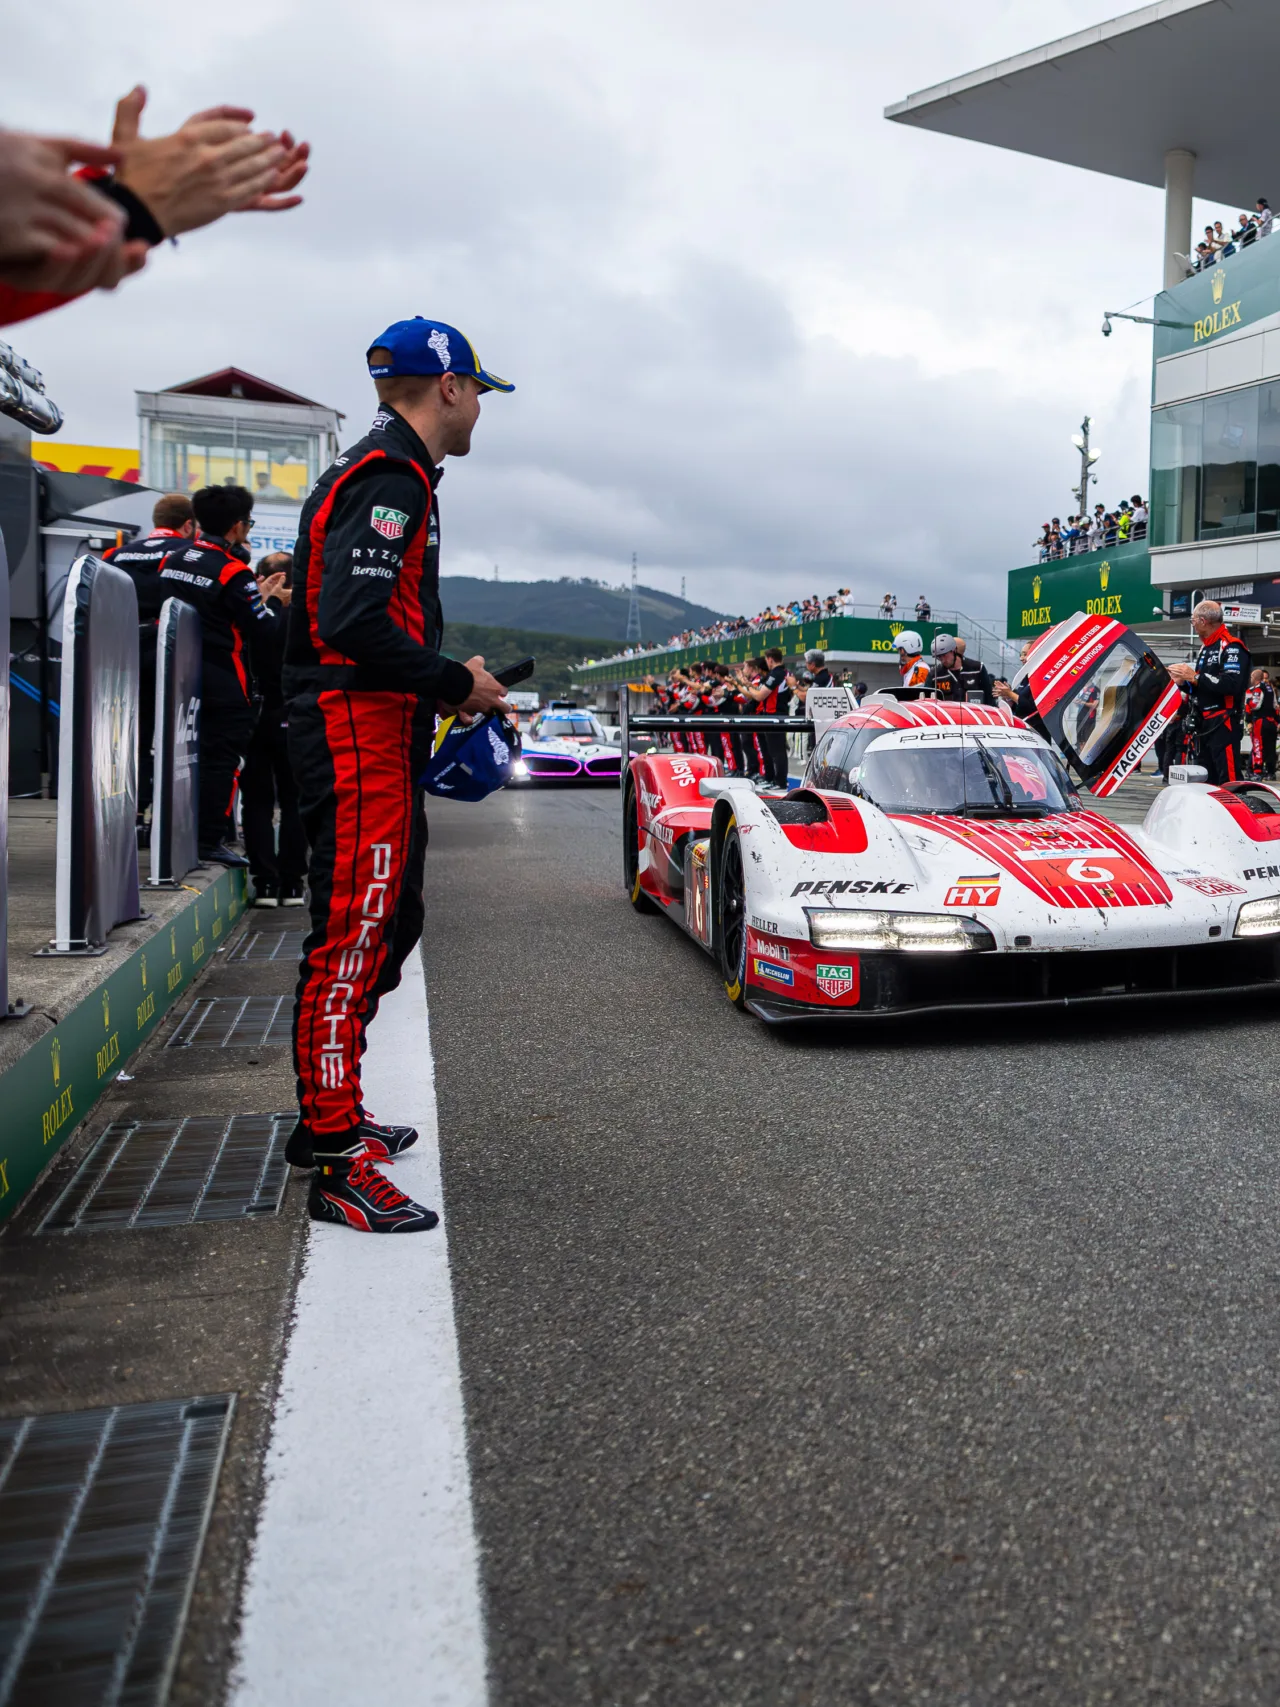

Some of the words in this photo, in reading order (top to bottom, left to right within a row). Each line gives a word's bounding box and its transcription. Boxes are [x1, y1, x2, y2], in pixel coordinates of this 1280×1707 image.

[1193, 300, 1242, 343] ROLEX
[377, 507, 408, 523] TAG
[373, 520, 403, 538] HEUE
[250, 538, 296, 549] STER
[352, 565, 396, 580] BergHO
[1086, 595, 1122, 615] ROLEX
[1021, 606, 1051, 627] ROLEX
[871, 640, 898, 651] RO
[813, 696, 847, 709] PORSCHE
[900, 731, 1040, 744] PORSCHE
[1112, 712, 1163, 781] TAGHeuer
[1066, 859, 1115, 883] 6
[790, 881, 914, 898] PENSKE
[947, 887, 994, 905] HY
[1196, 883, 1240, 895] CAR
[752, 915, 778, 934] HELLER
[757, 939, 780, 959] Mobil
[320, 843, 391, 1090] PORSCHE
[765, 967, 790, 980] MICHELIN
[819, 966, 849, 979] TAG
[818, 979, 850, 996] HEUER
[136, 991, 155, 1031] ROLEX
[96, 1031, 120, 1080] ROLEX
[42, 1083, 74, 1145] ROLEX
